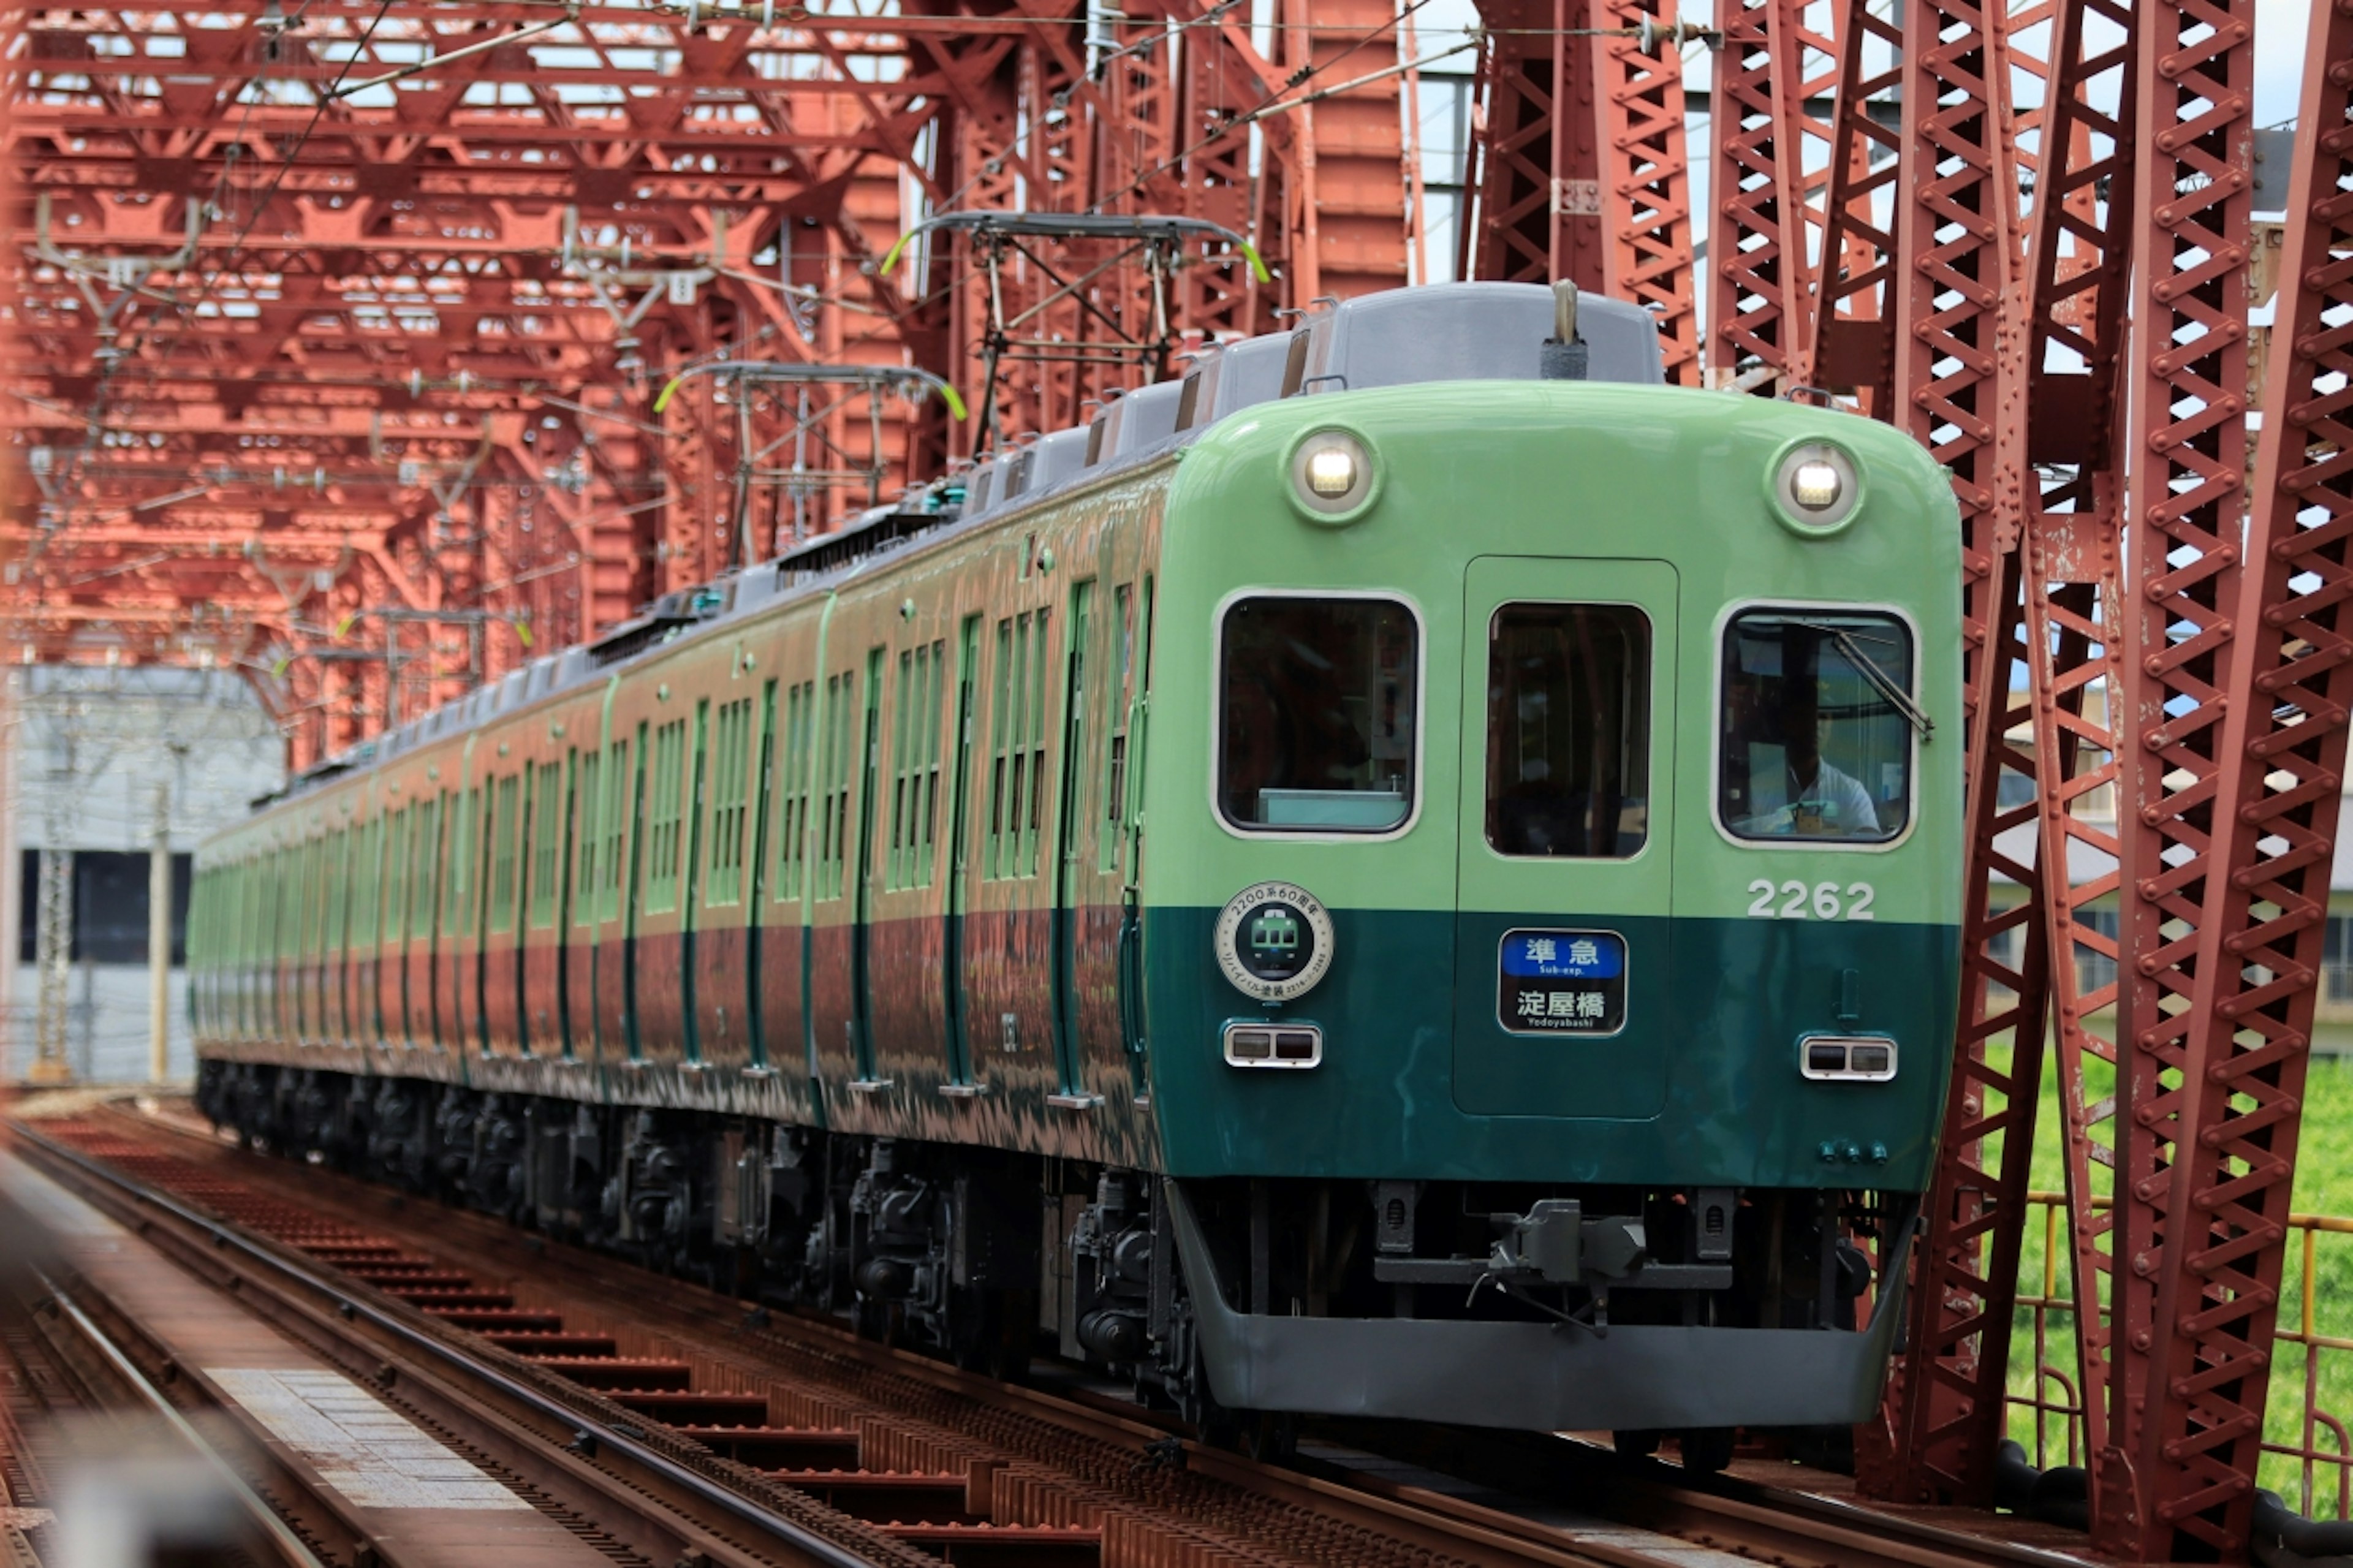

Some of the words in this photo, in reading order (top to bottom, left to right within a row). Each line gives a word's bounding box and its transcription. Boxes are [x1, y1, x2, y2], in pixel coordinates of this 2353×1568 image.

[1231, 887, 1319, 916] 2200系60周年
[1748, 879, 1874, 920] 2262
[1525, 938, 1599, 965] 準急
[1539, 965, 1584, 976] Sub-exp.
[1517, 990, 1604, 1017] 淀屋橋
[1528, 1018, 1593, 1028] Yodoyabashi
